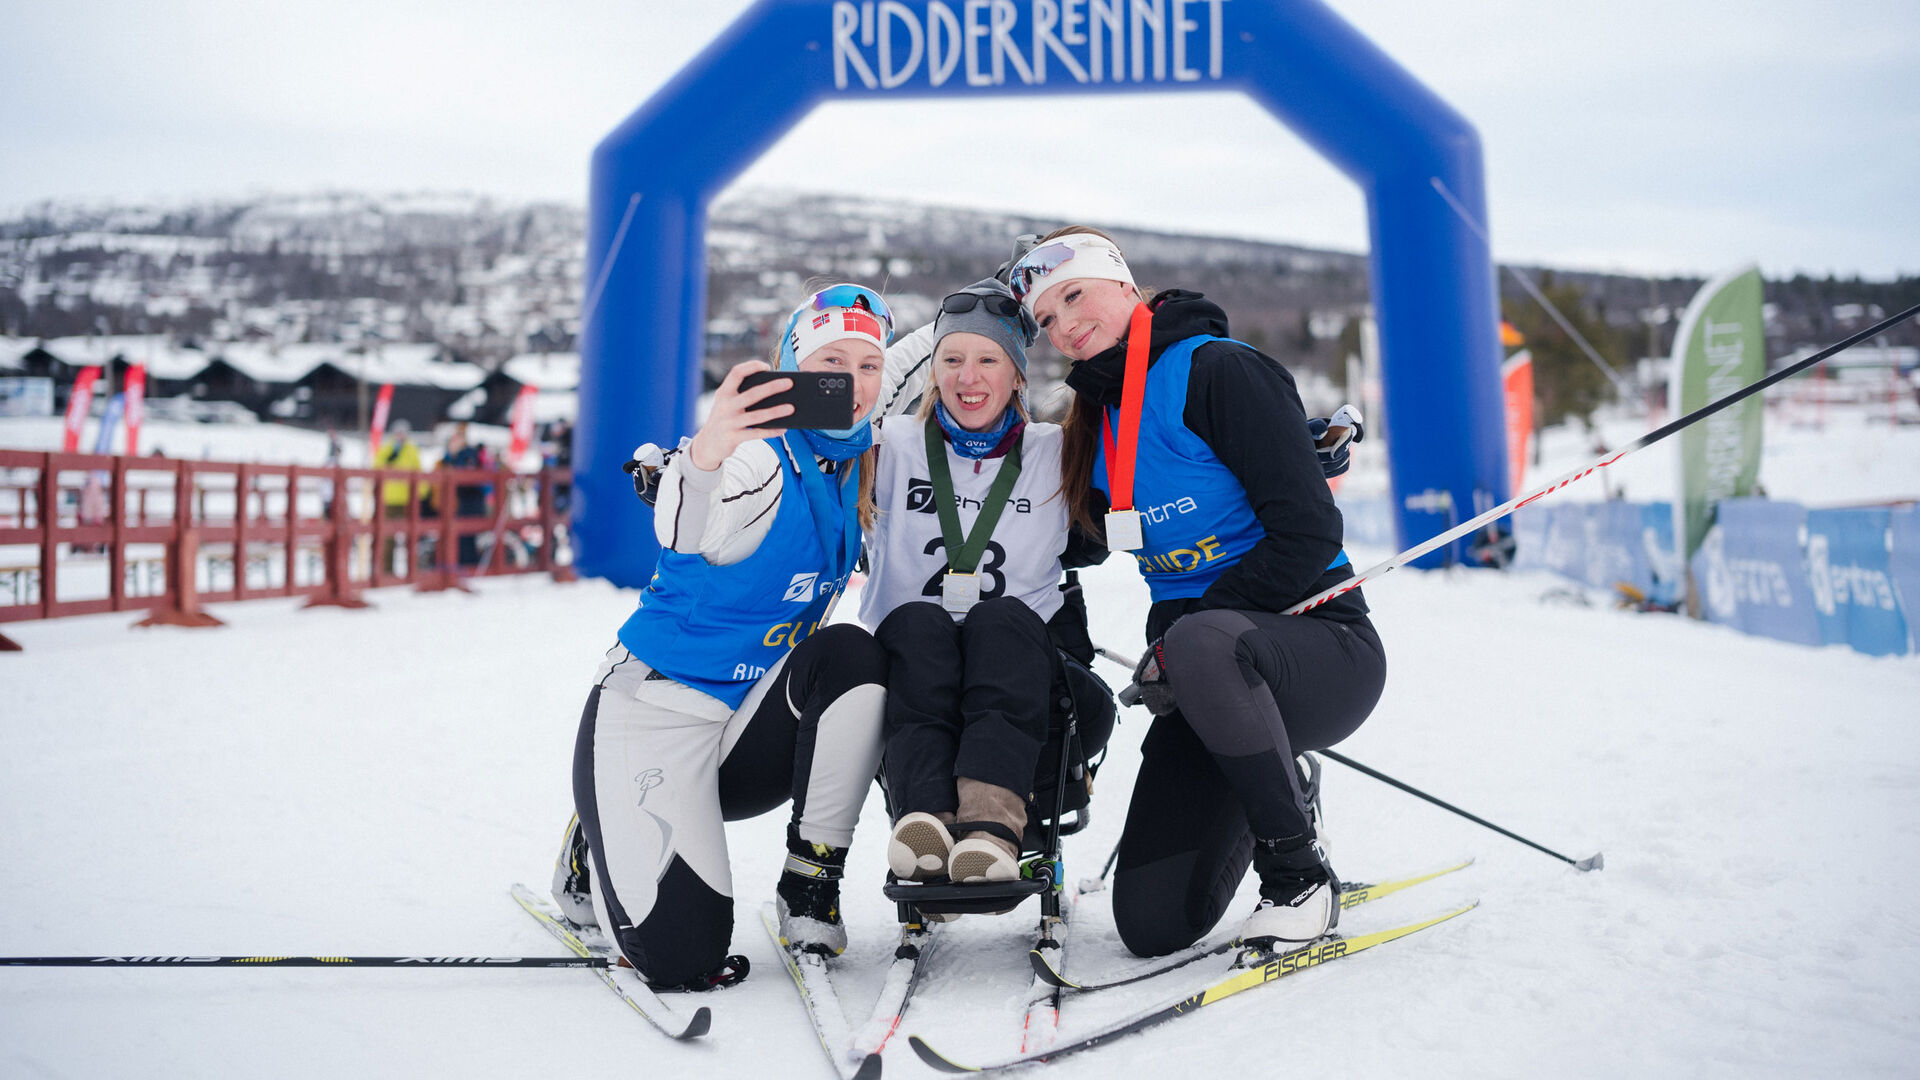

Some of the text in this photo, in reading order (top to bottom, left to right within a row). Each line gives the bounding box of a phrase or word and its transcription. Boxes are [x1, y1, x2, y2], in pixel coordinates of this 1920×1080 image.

[832, 0, 1226, 89] RIDDERRENNET
[1140, 496, 1197, 526] ntra
[922, 537, 1006, 600] 23
[733, 663, 766, 681] RID
[1340, 890, 1368, 910] HER
[1264, 941, 1347, 982] FISCHER
